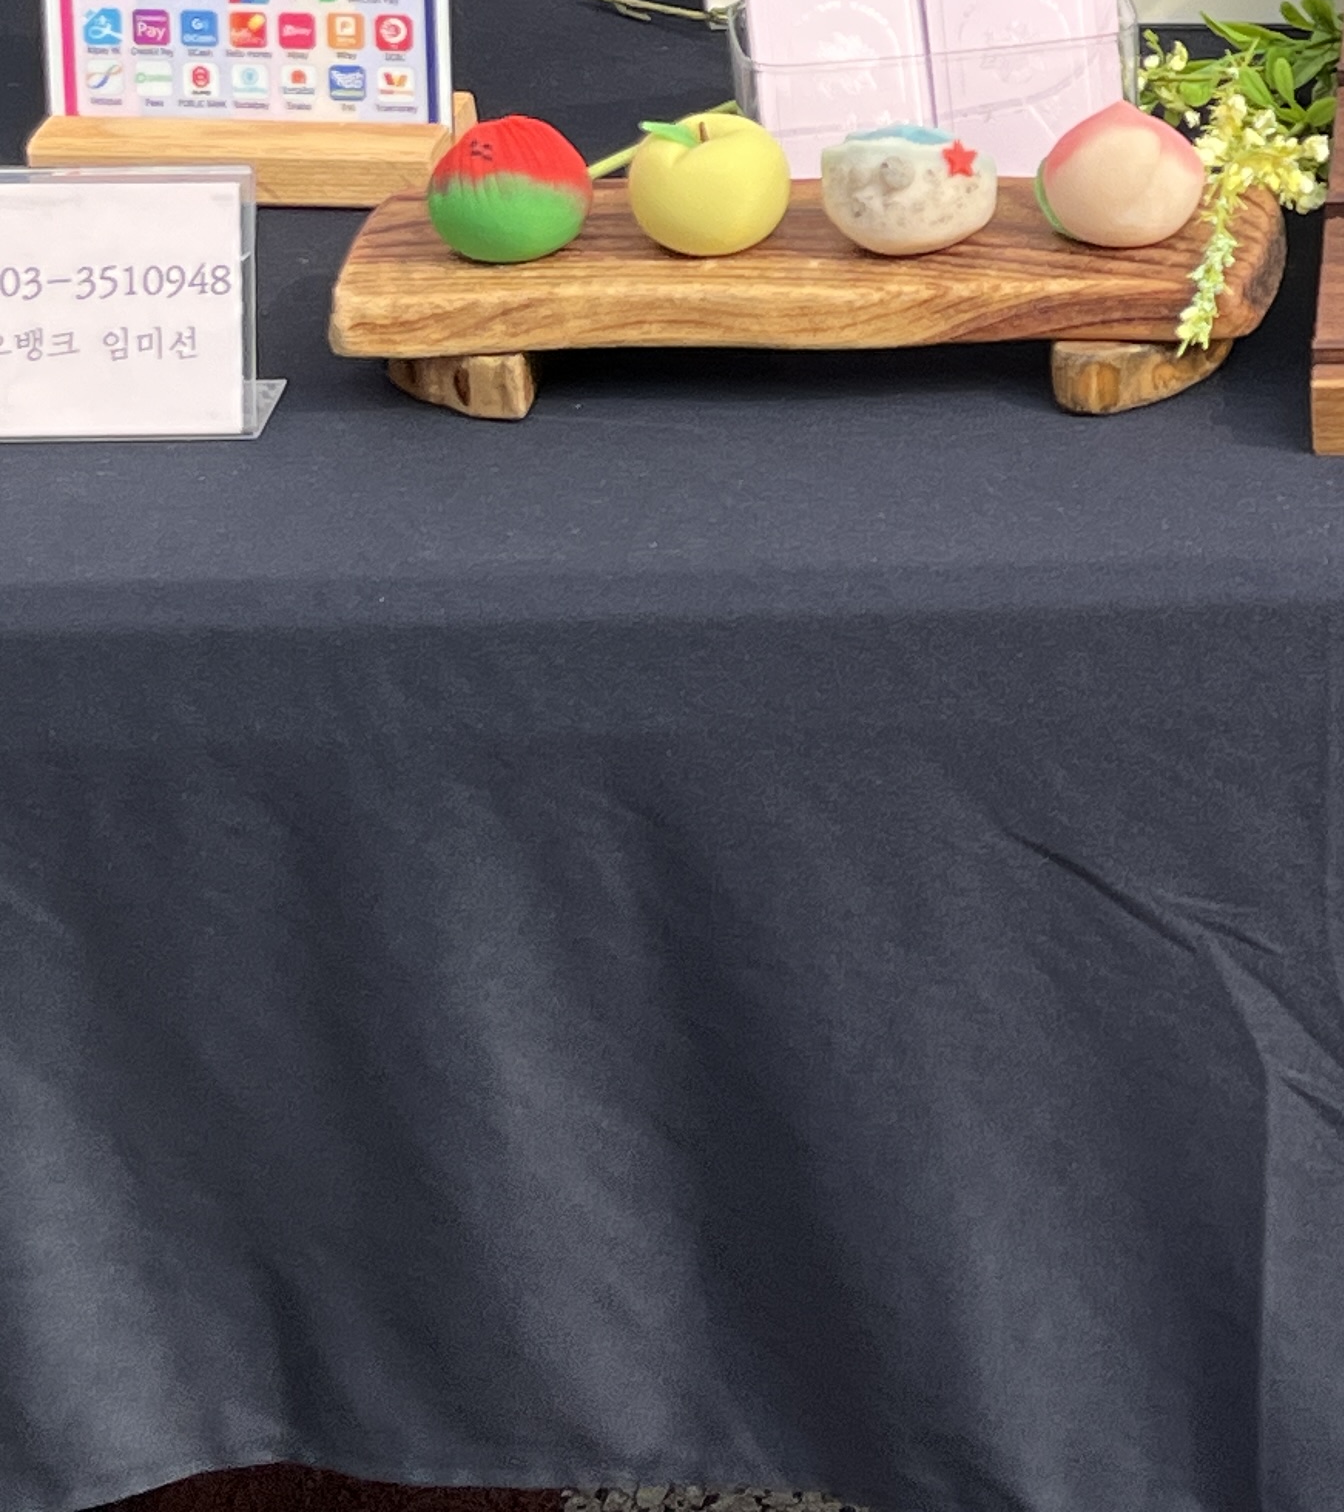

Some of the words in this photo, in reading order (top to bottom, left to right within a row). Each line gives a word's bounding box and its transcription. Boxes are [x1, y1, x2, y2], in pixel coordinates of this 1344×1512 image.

[137, 23, 166, 39] Pay
[0, 263, 232, 300] 03-3510948
[103, 326, 199, 362] 임미선
